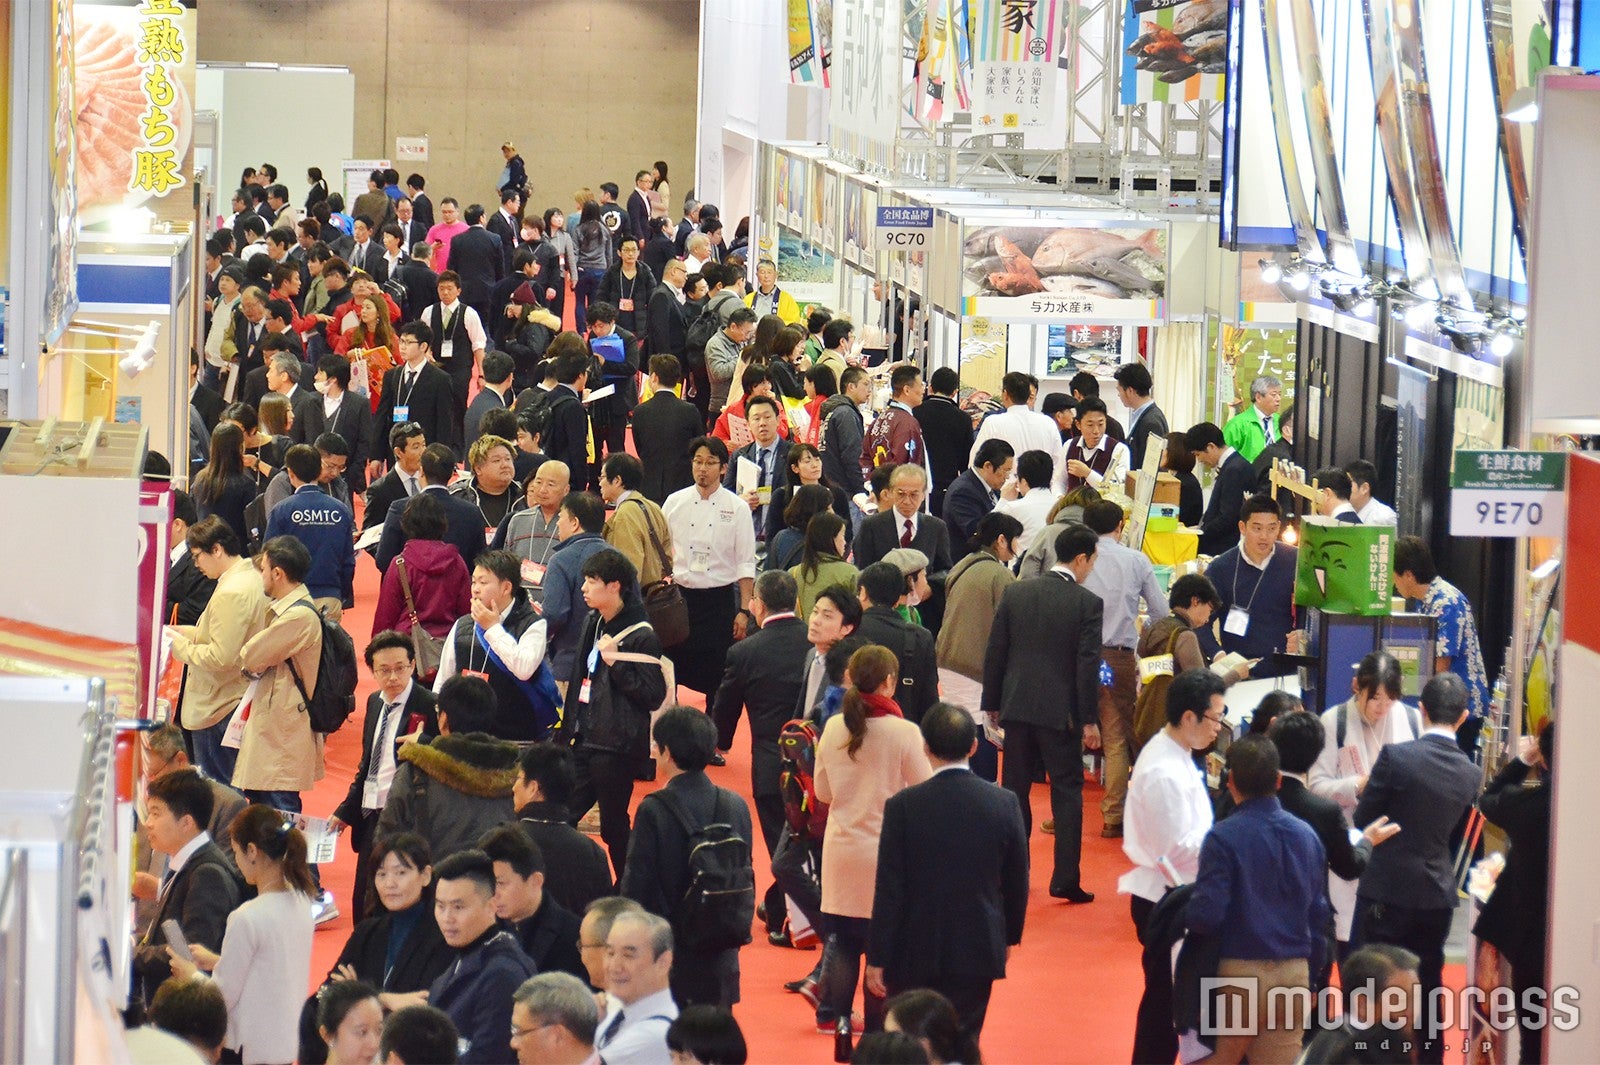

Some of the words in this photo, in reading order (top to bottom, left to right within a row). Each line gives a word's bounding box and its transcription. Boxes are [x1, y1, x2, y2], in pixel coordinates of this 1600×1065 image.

[1001, 67, 1012, 94] 家族で
[1015, 67, 1026, 104] いろんな
[883, 210, 929, 220] 全国食品博
[886, 232, 925, 245] 9C70
[1478, 454, 1544, 471] 生鮮食材
[1476, 501, 1543, 525] 9E70
